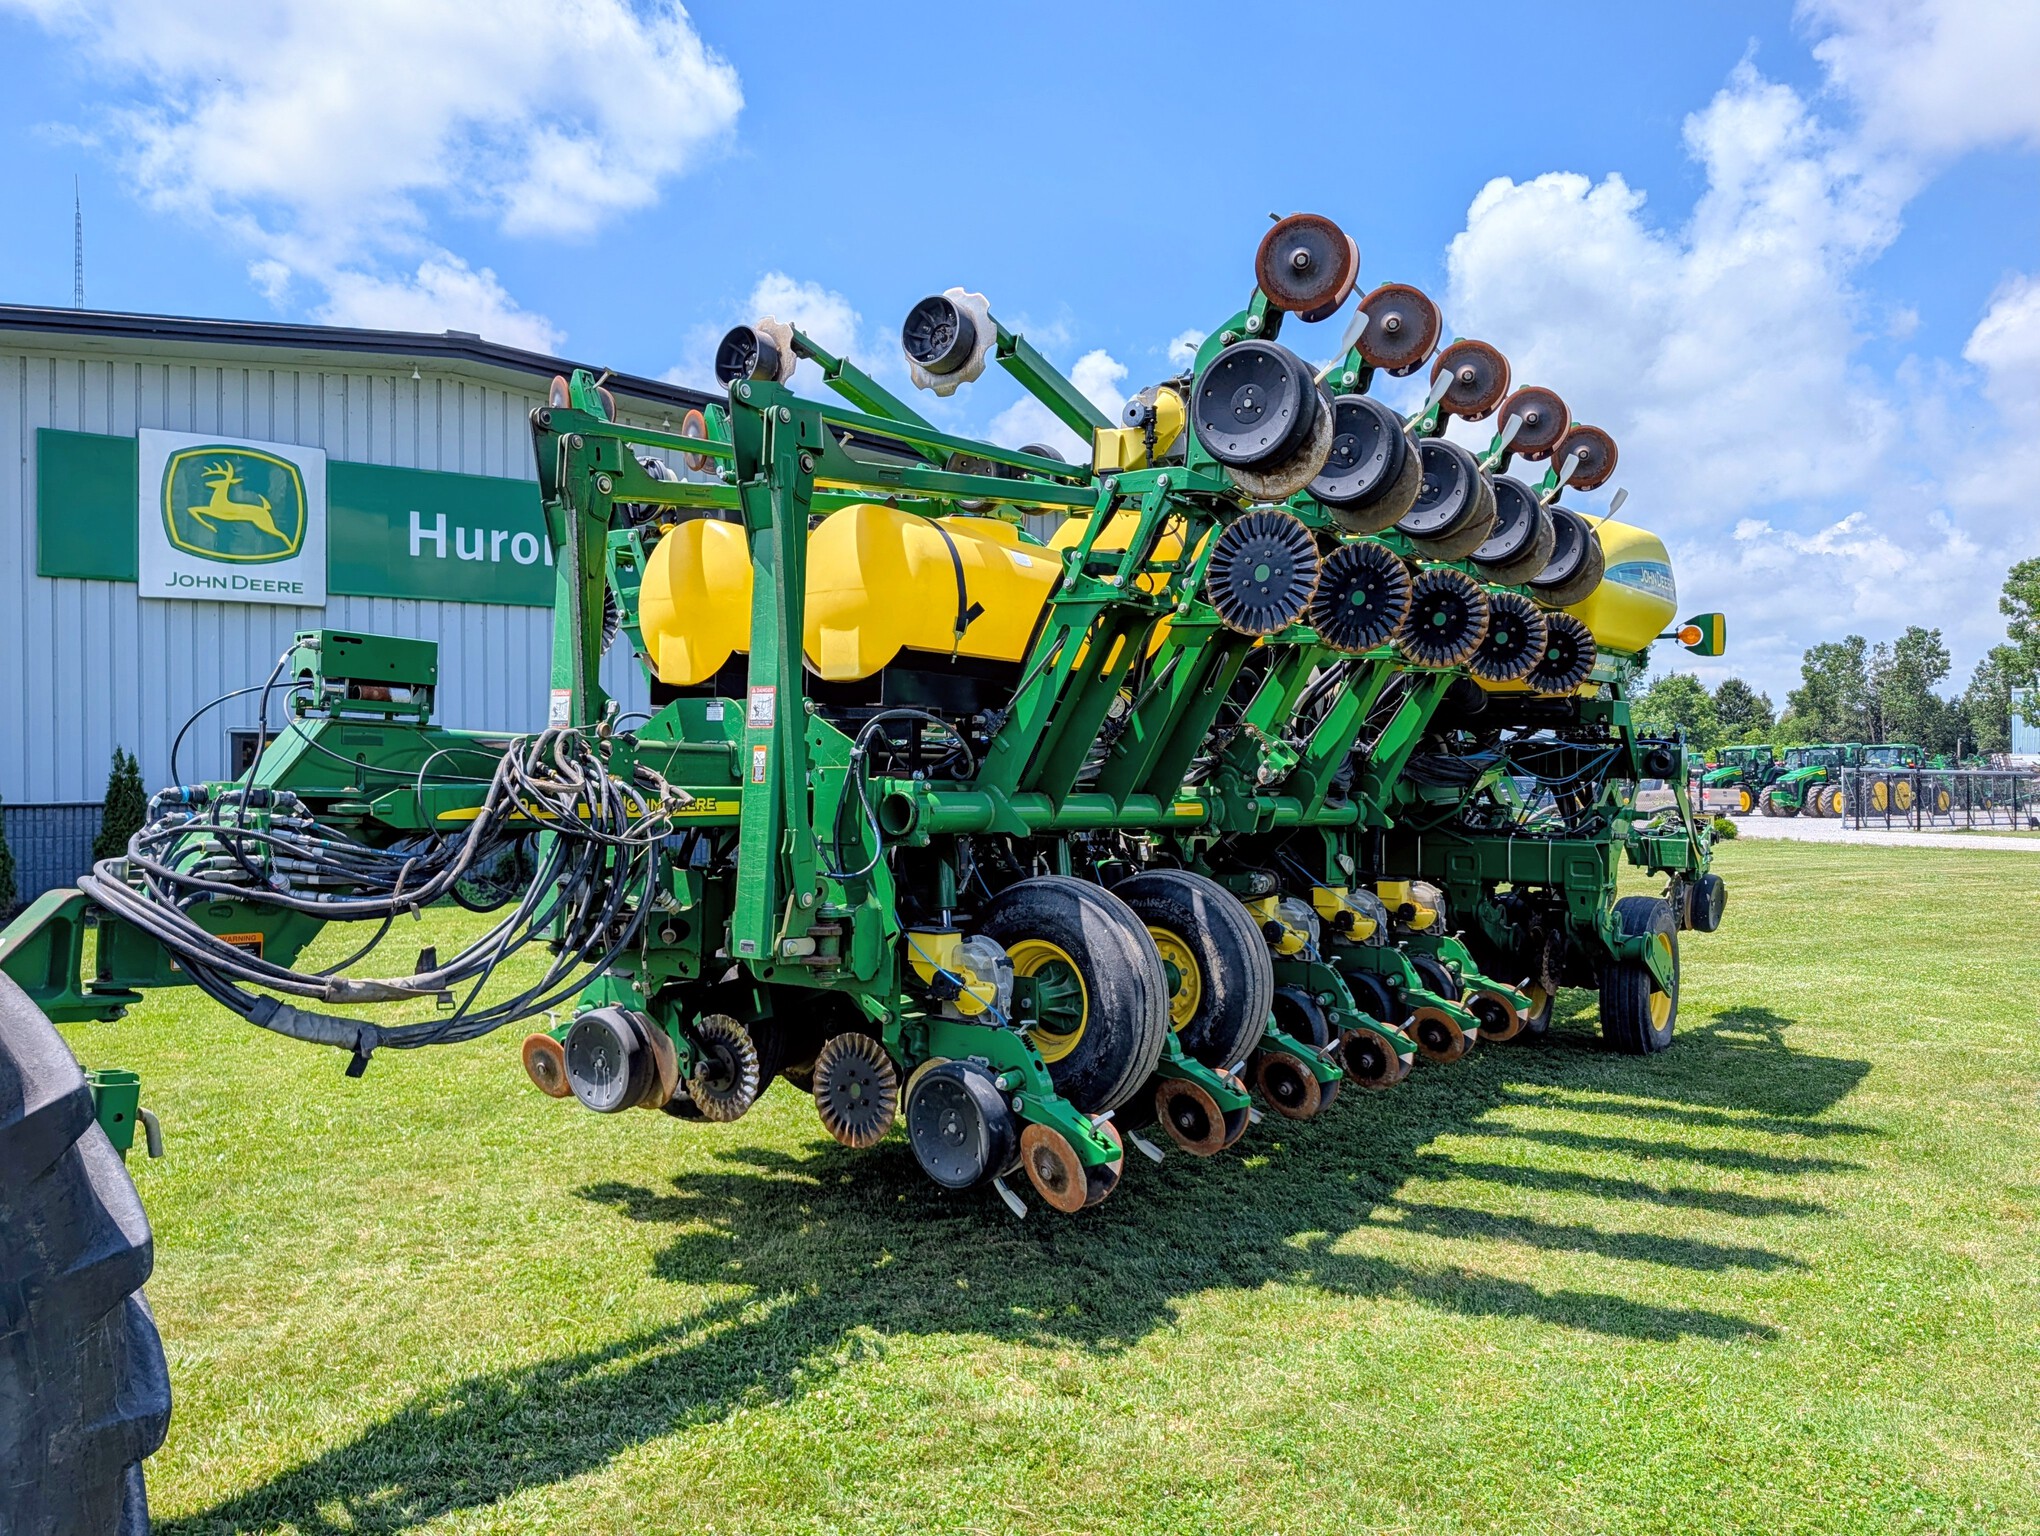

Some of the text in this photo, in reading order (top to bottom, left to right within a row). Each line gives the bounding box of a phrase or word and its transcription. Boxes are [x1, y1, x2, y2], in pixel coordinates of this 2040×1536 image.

[165, 571, 304, 594] JOHN DEERE
[1640, 566, 1658, 586] JOHN
